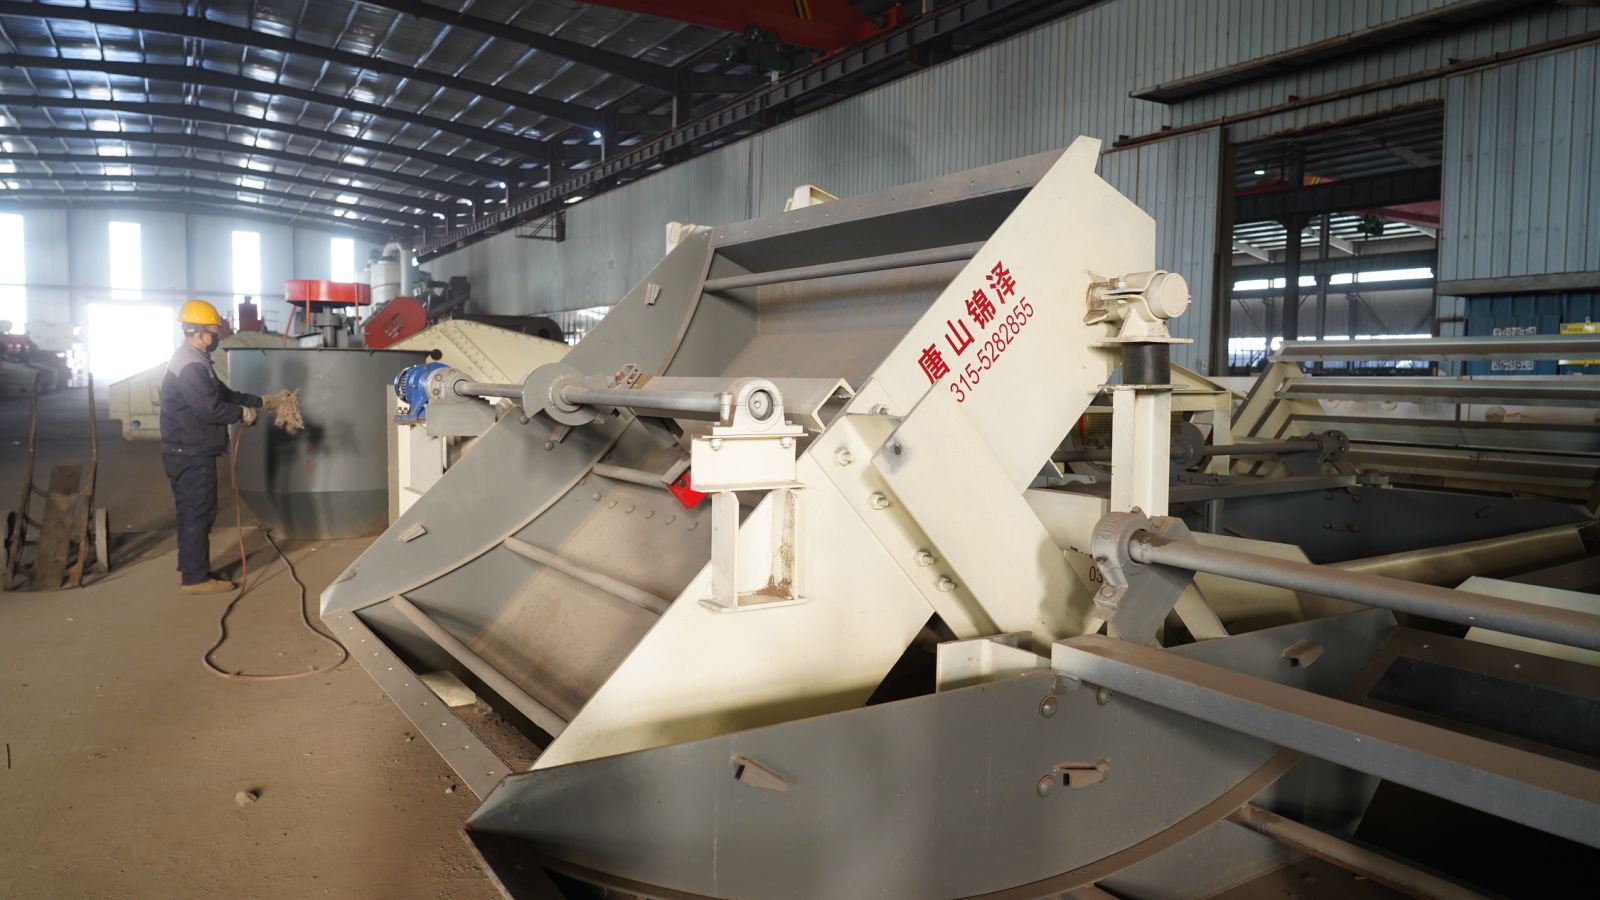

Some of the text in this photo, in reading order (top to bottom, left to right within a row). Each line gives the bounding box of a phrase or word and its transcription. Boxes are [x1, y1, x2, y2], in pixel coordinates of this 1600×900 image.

[917, 260, 1016, 385] 唐山锦泽
[950, 296, 1034, 403] 315-5282855
